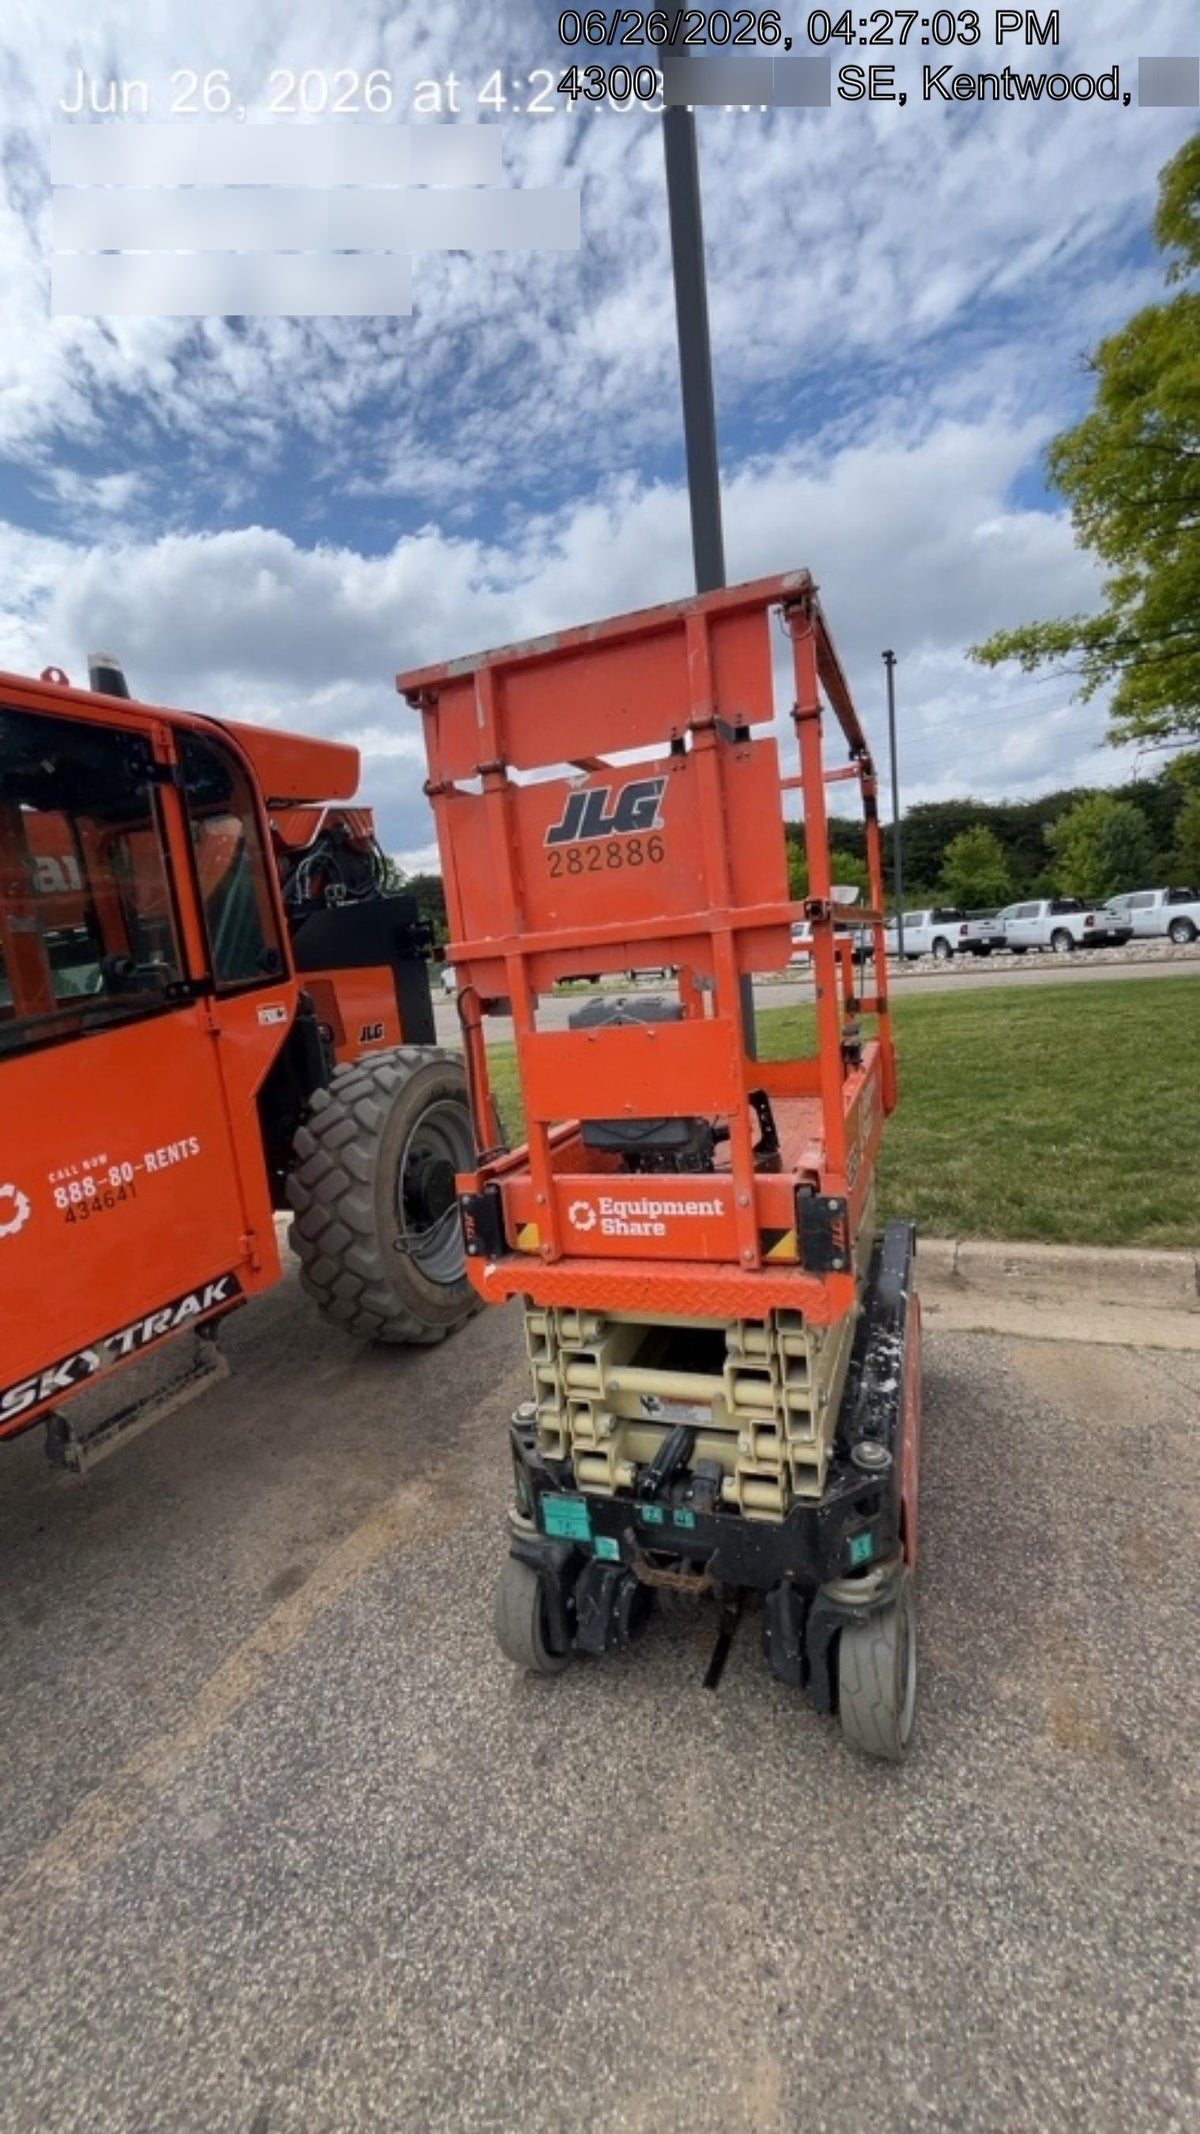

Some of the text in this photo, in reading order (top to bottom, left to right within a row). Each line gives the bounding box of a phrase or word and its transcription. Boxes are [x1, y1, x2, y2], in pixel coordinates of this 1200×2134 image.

[543, 775, 669, 847] JLG
[546, 835, 665, 878] 282886
[359, 1021, 385, 1044] JLG
[48, 1153, 108, 1184] CALL NOW
[53, 1136, 201, 1208] 888-80-RENTS
[65, 1181, 137, 1223] 434641
[597, 1197, 725, 1219] Equipment
[601, 1218, 666, 1236] Share
[0, 1275, 229, 1422] SKYTRAK
